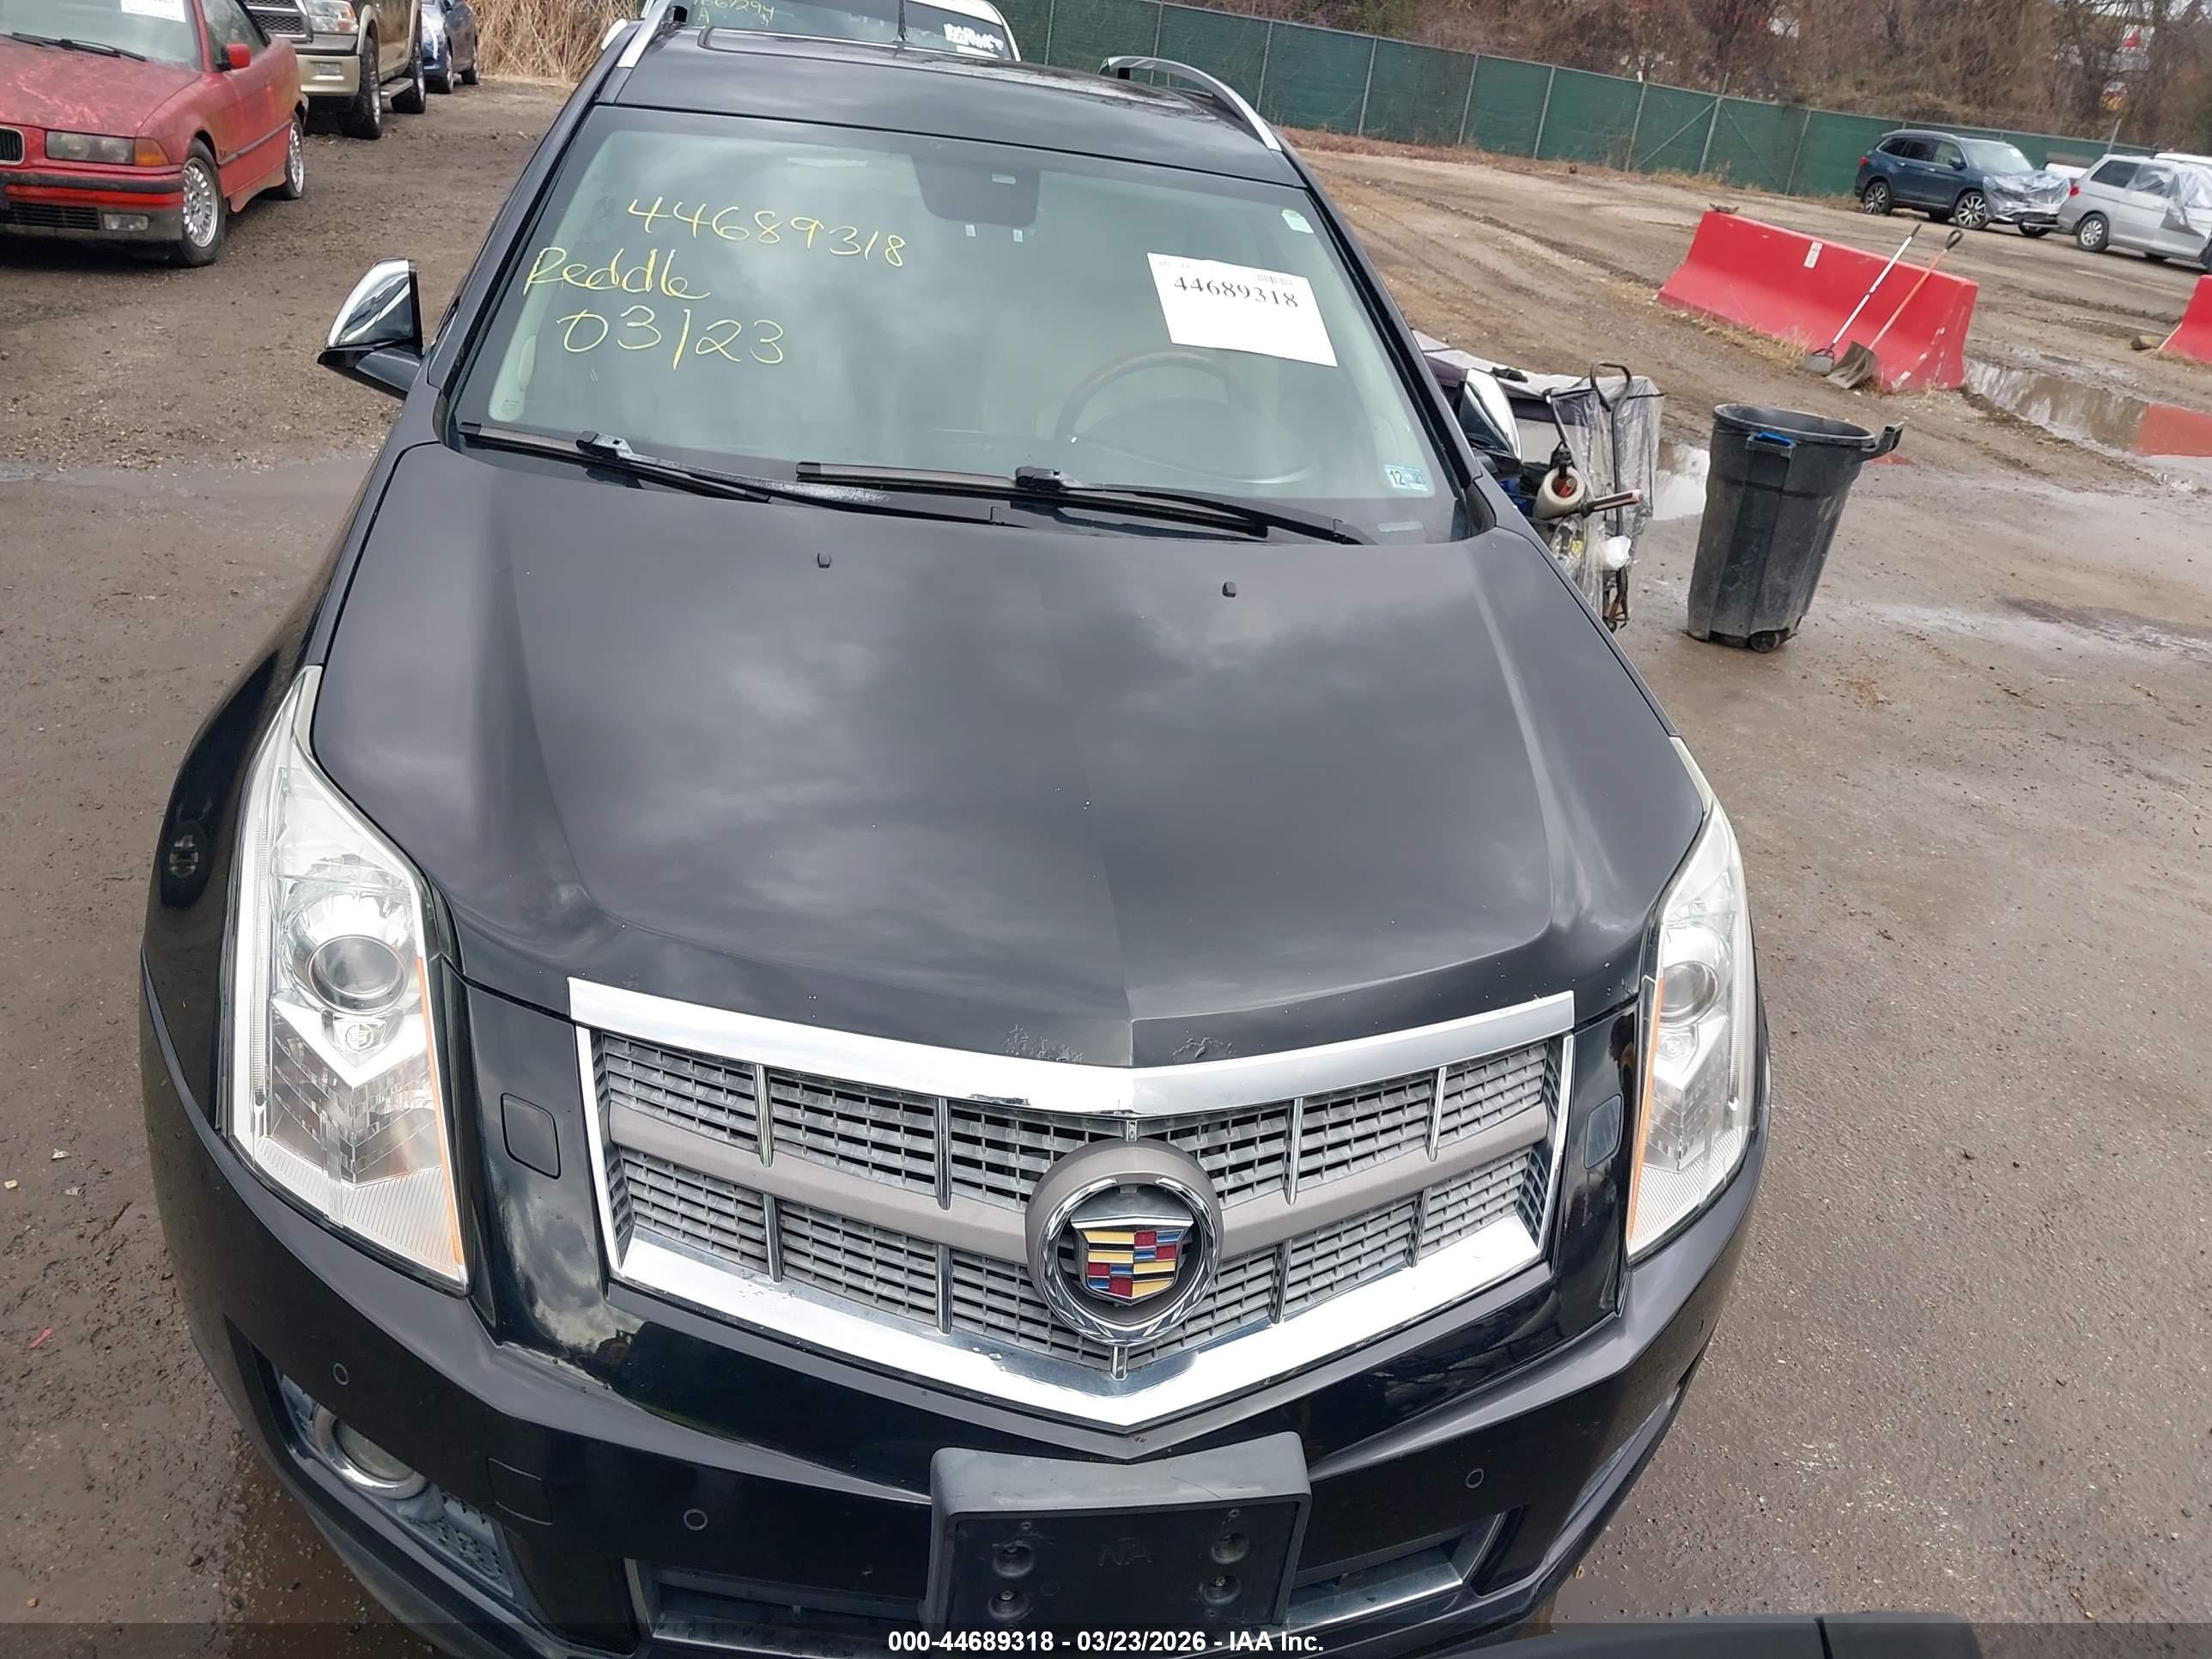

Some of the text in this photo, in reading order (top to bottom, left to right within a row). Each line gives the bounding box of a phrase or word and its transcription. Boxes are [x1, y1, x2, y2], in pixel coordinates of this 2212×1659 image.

[628, 196, 906, 267] 44689318
[1174, 276, 1299, 308] 44689318
[556, 305, 784, 371] 03/23
[1389, 469, 1406, 486] 12
